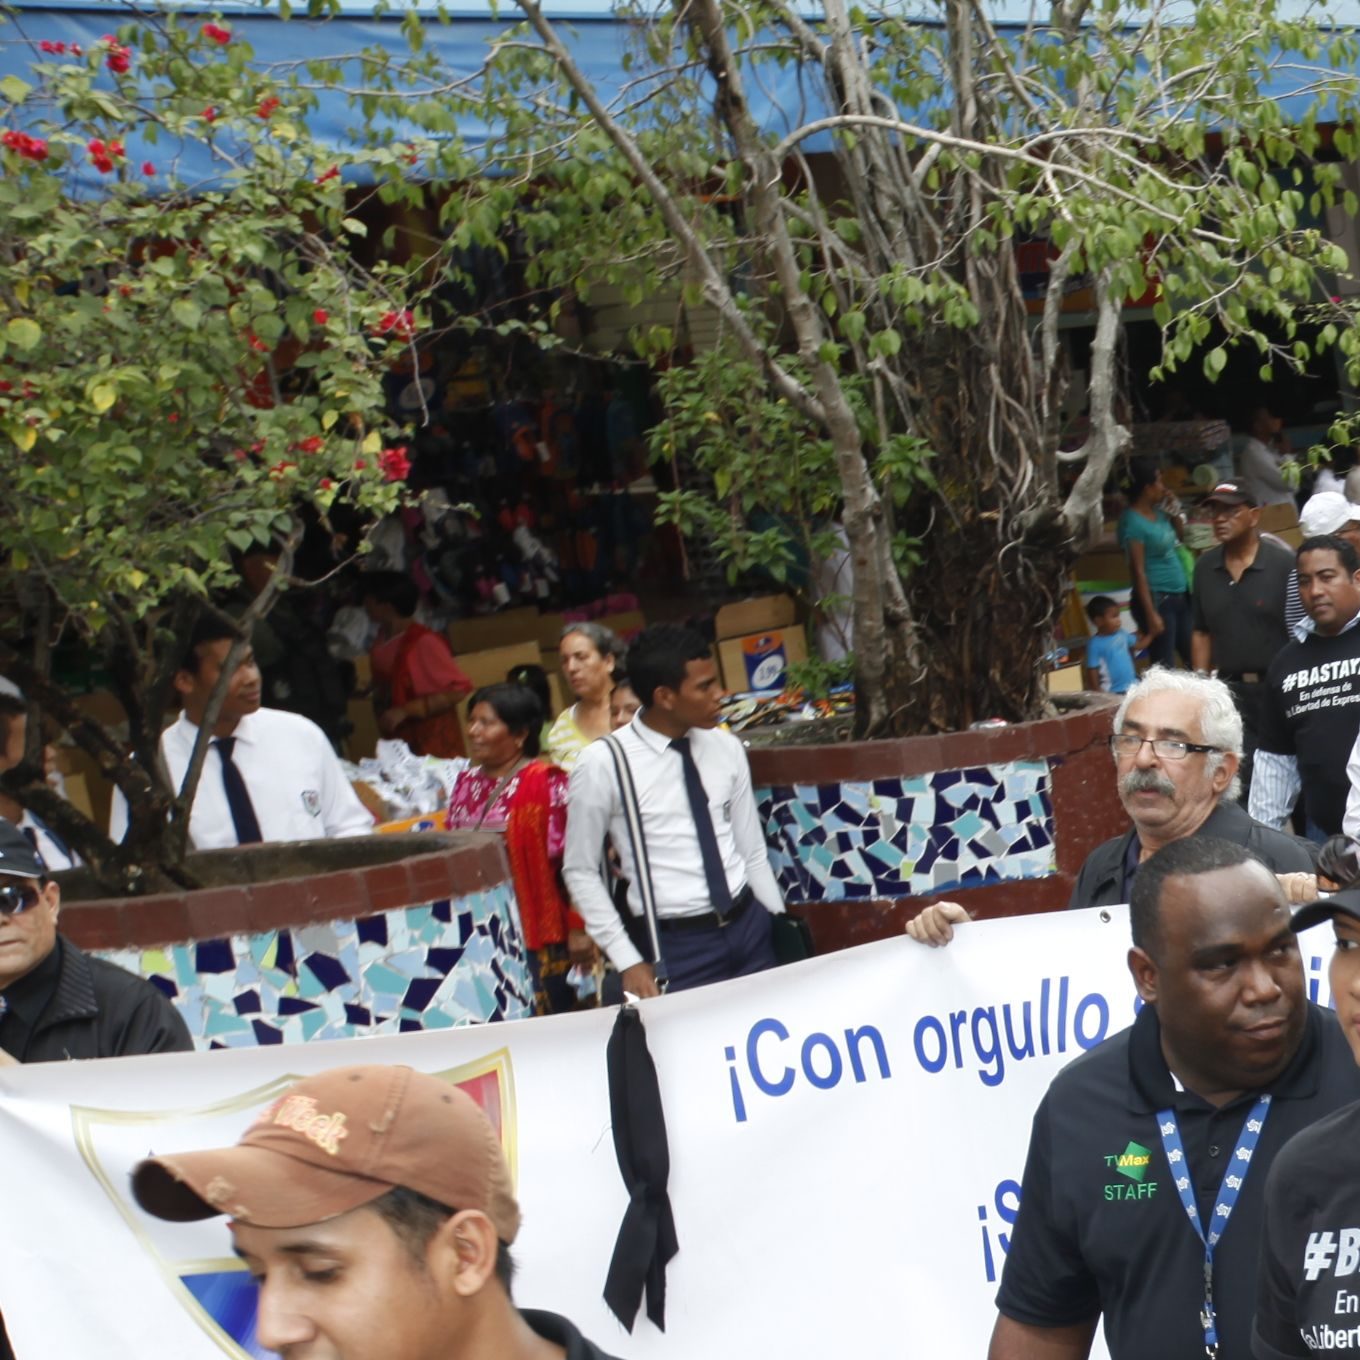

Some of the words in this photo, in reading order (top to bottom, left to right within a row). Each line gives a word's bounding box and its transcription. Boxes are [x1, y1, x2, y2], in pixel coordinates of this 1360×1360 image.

[1300, 690, 1310, 702] En
[724, 1017, 893, 1123] ¡Con
[913, 976, 1110, 1088] orgullo
[1104, 1182, 1158, 1200] STAFF
[1335, 1289, 1359, 1315] En
